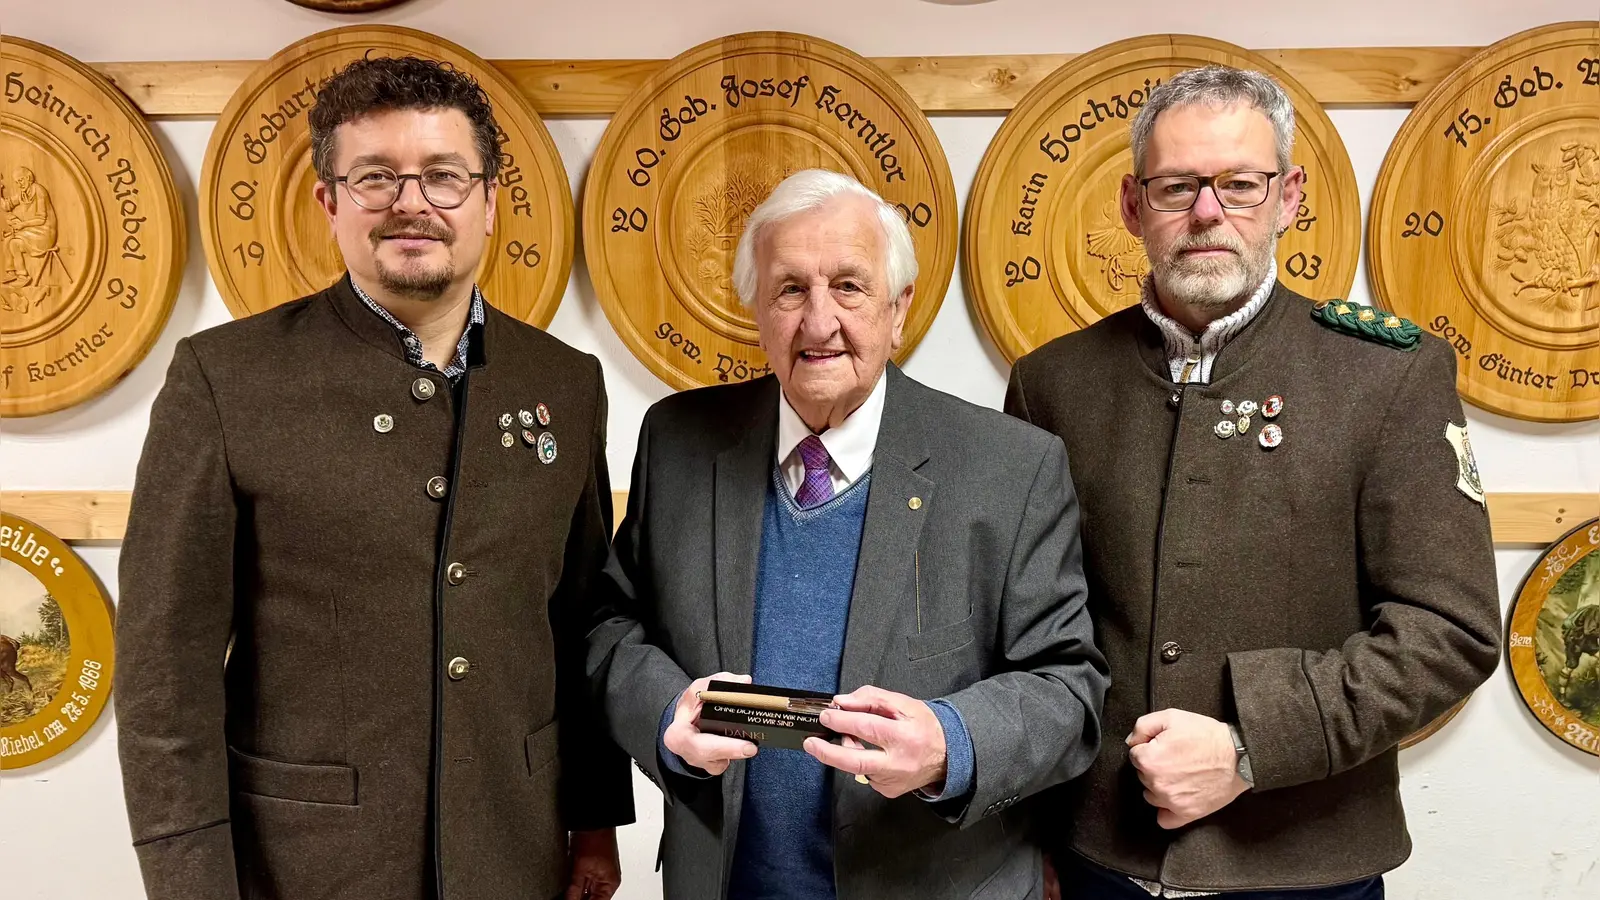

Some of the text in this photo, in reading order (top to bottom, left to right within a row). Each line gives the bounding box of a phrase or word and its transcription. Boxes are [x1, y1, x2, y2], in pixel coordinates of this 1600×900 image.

[243, 68, 337, 164] Geburt
[1444, 108, 1491, 147] 75.
[1494, 66, 1563, 108] Geb.
[626, 74, 906, 187] 60. Geb. Josef Kerntler
[4, 71, 147, 261] Heinrich Riebel
[1011, 172, 1048, 237] Karin
[1039, 77, 1160, 163] Hochzei
[229, 179, 259, 221] 60.
[611, 206, 648, 233] 20
[1401, 210, 1444, 238] 20
[232, 240, 541, 268] 19 96
[1004, 251, 1322, 288] 20 03
[106, 277, 138, 310] 93
[27, 322, 114, 383] Kerntler
[1479, 353, 1558, 389] Günter
[1, 730, 45, 757] Riebel
[78, 659, 102, 691] 1966
[776, 720, 794, 728] SIND
[724, 728, 768, 740] DANKE
